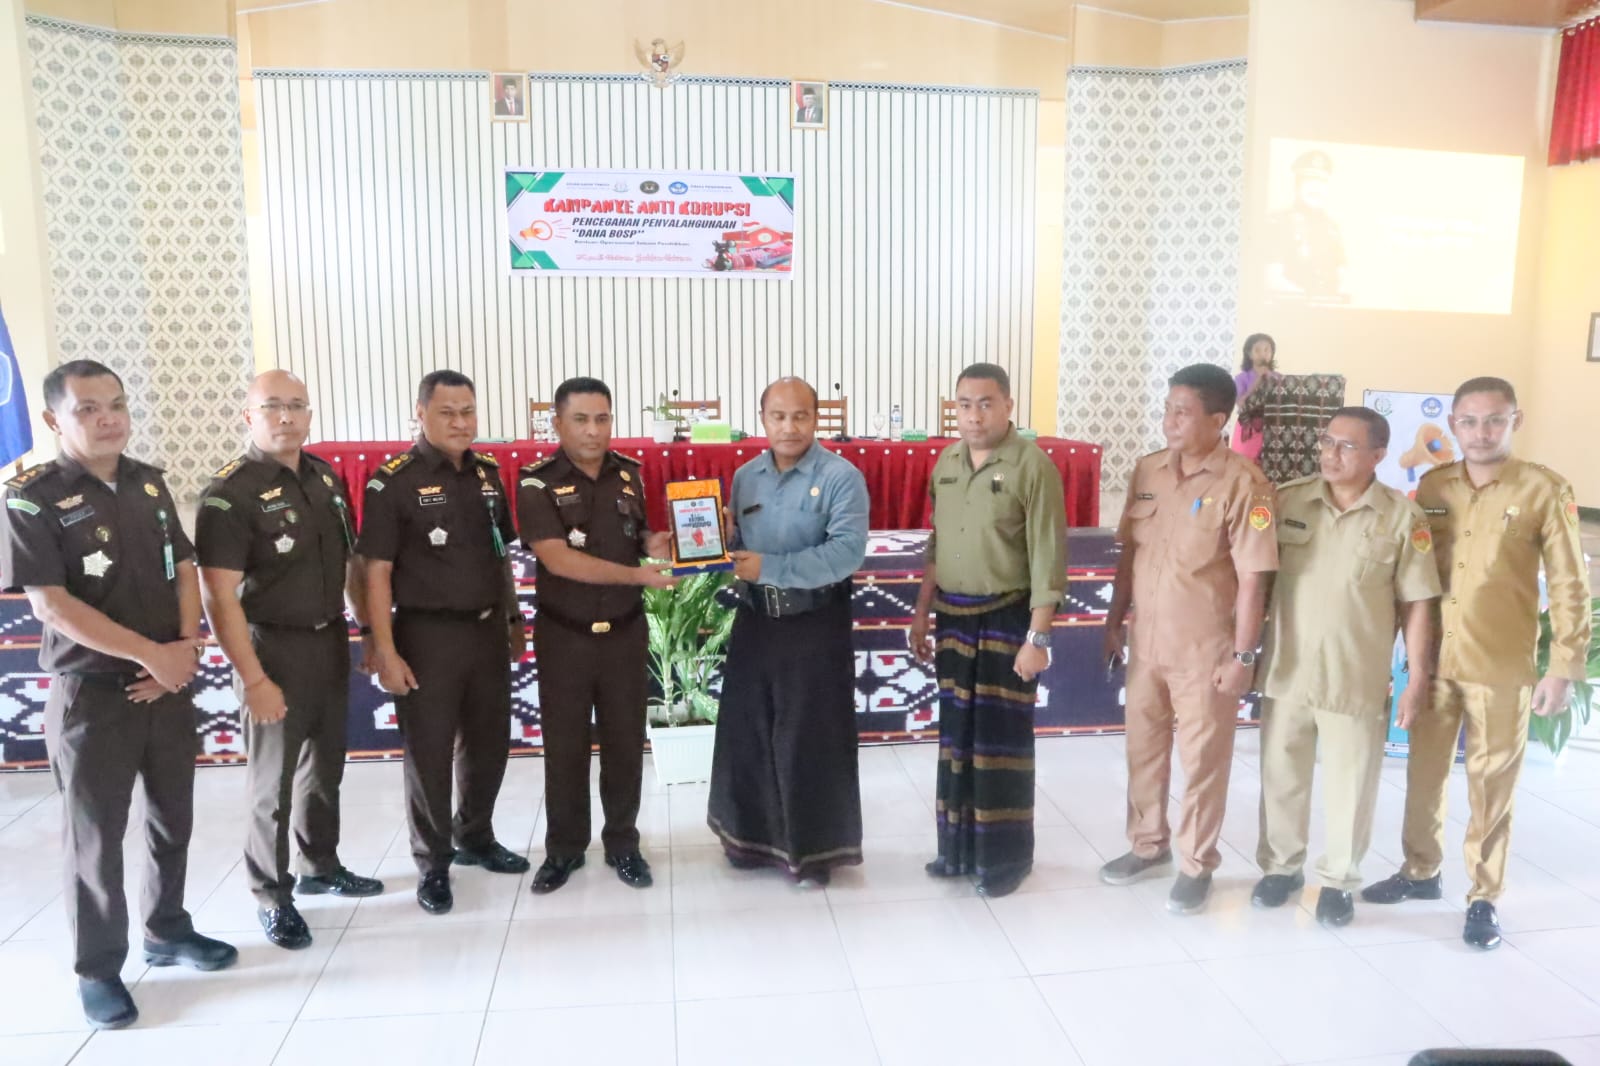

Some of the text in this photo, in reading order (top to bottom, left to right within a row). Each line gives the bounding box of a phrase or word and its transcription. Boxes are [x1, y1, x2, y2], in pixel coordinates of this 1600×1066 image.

[544, 198, 751, 216] KAMPANYE ANTI KORUPSI
[572, 217, 737, 229] PENCEGAHAN PENYALAHGUNAAN
